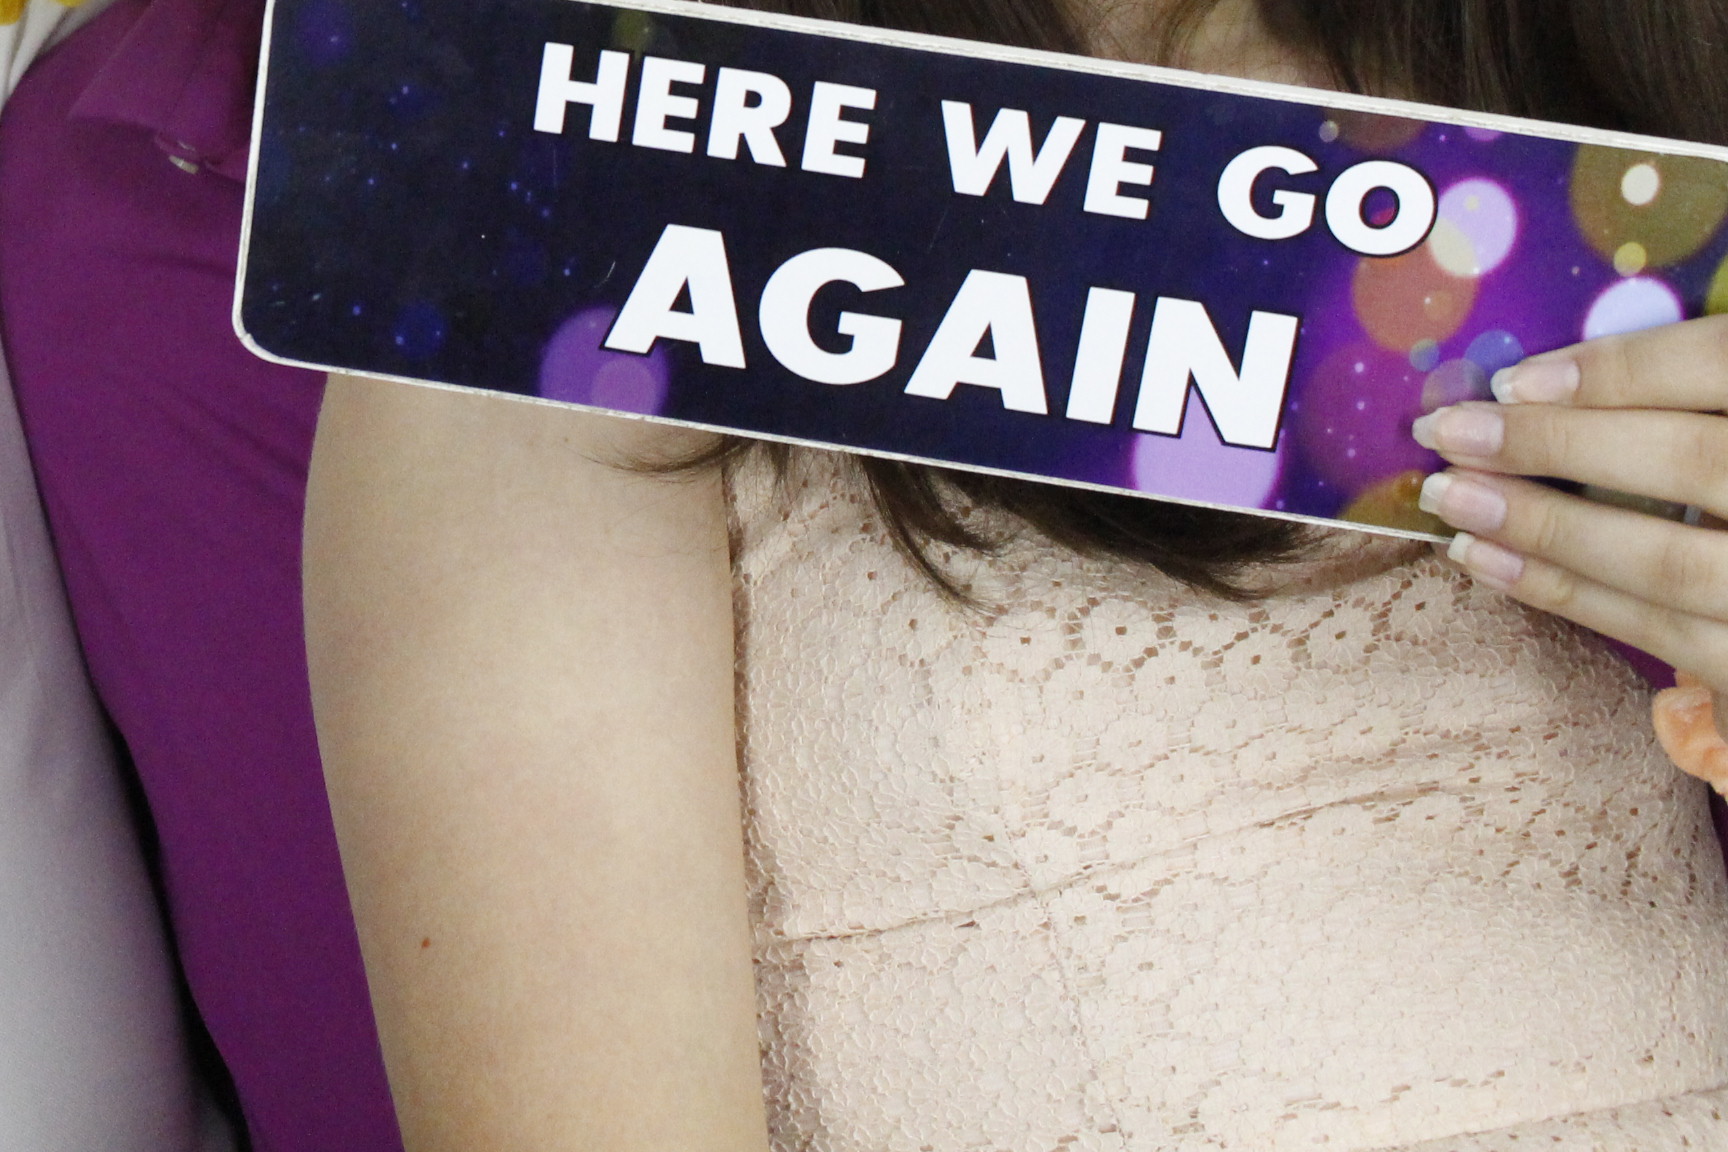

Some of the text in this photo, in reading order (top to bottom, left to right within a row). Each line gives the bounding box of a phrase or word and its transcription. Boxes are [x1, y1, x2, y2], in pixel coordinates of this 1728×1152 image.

[532, 41, 1436, 256] HERE WE GO
[604, 223, 1298, 449] AGAIN
